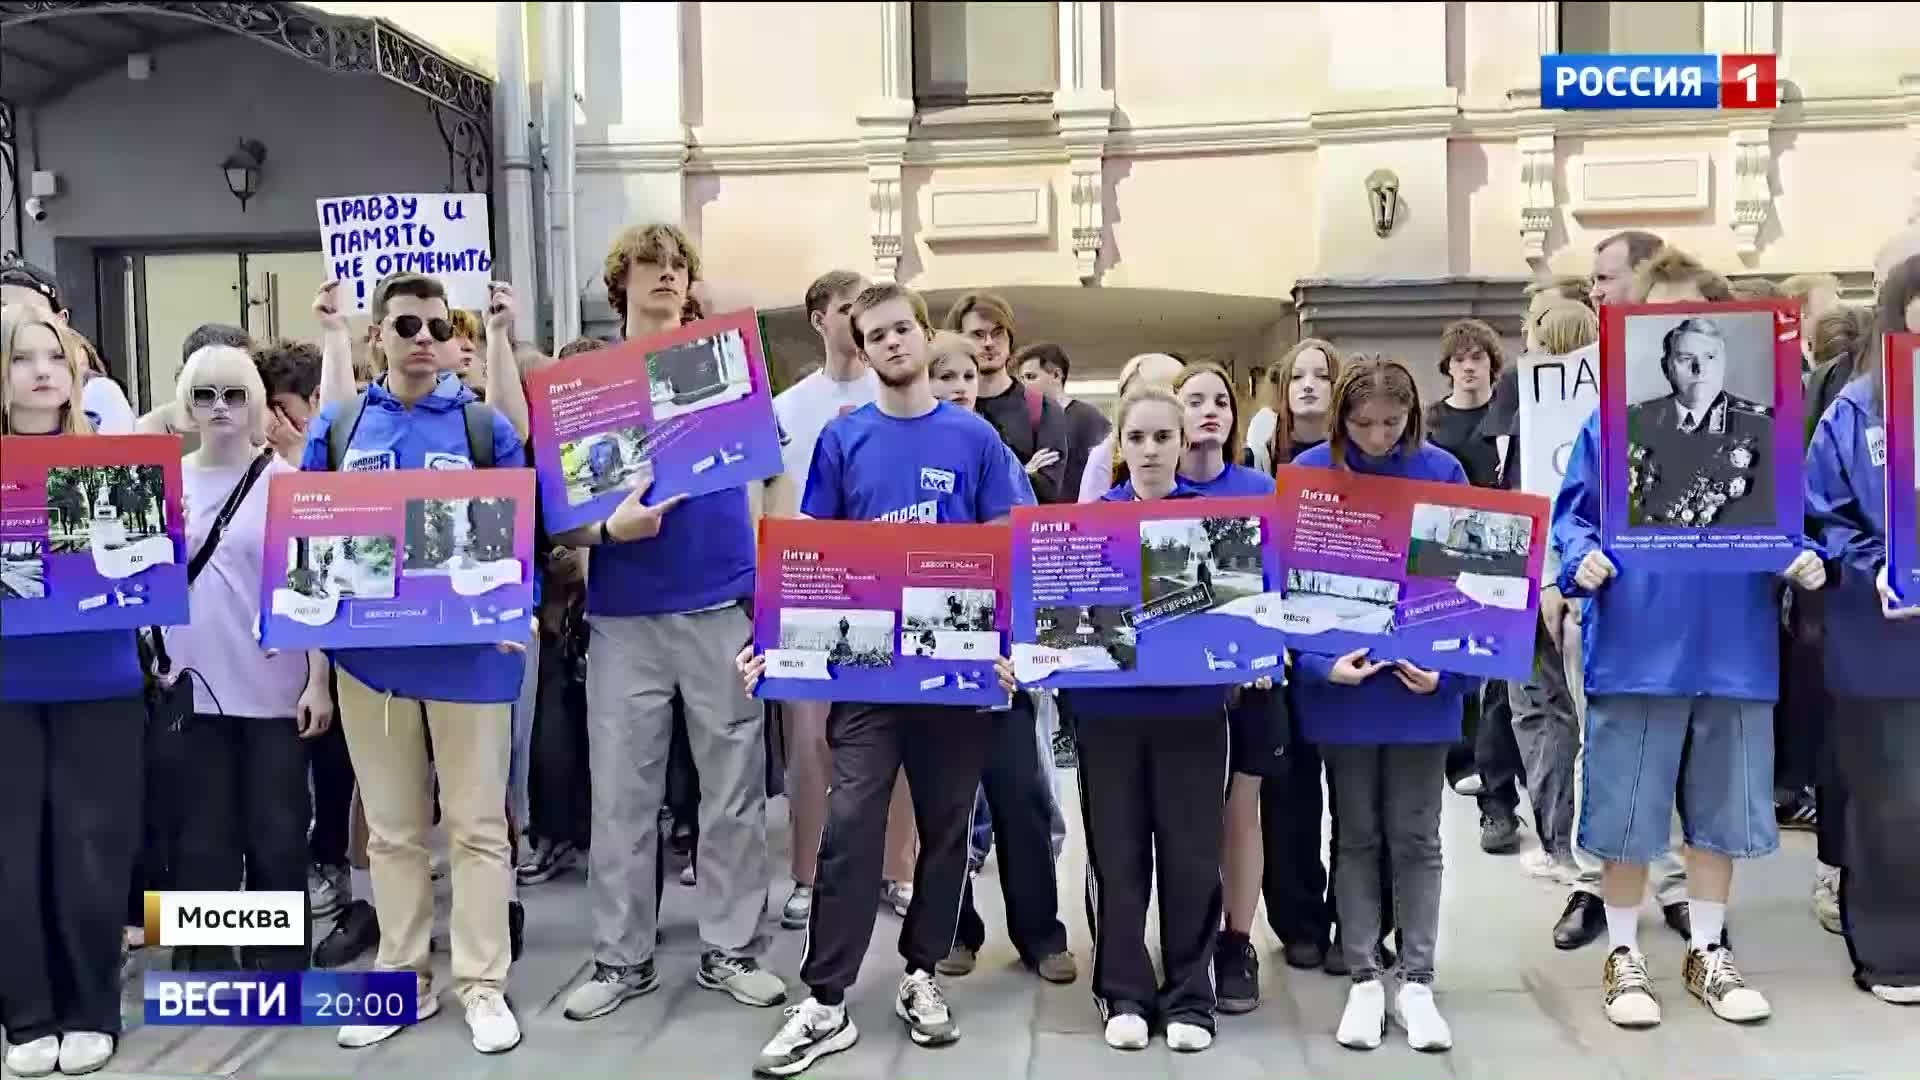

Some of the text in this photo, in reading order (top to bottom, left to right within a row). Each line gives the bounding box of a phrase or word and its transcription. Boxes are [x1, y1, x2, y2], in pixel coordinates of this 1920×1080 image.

[330, 223, 435, 257] ПАМЯТЬ
[335, 249, 492, 280] НЕ ОТМЕНИТЬ
